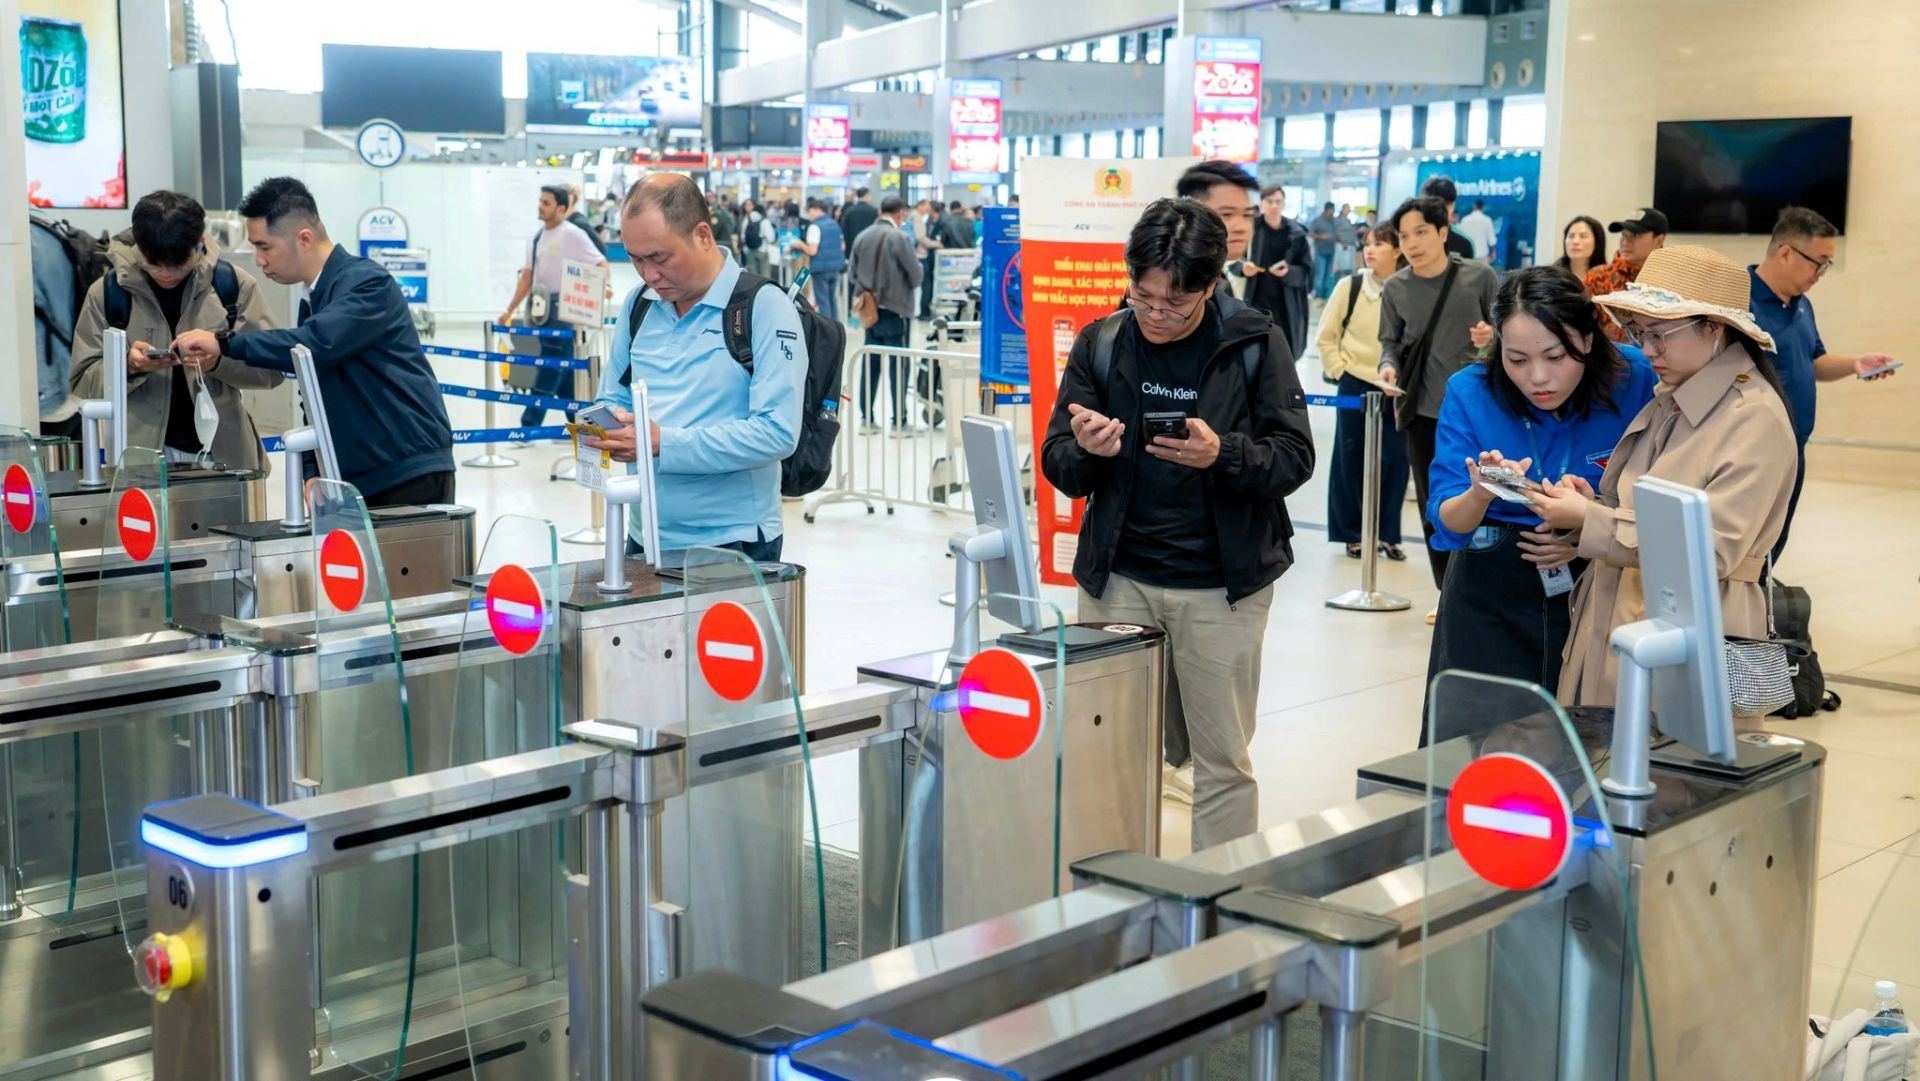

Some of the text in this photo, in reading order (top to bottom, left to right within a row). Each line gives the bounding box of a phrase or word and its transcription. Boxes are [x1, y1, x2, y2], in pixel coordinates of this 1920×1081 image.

[370, 215, 395, 225] ACV
[1173, 388, 1198, 400] Klein
[169, 875, 187, 909] 06
